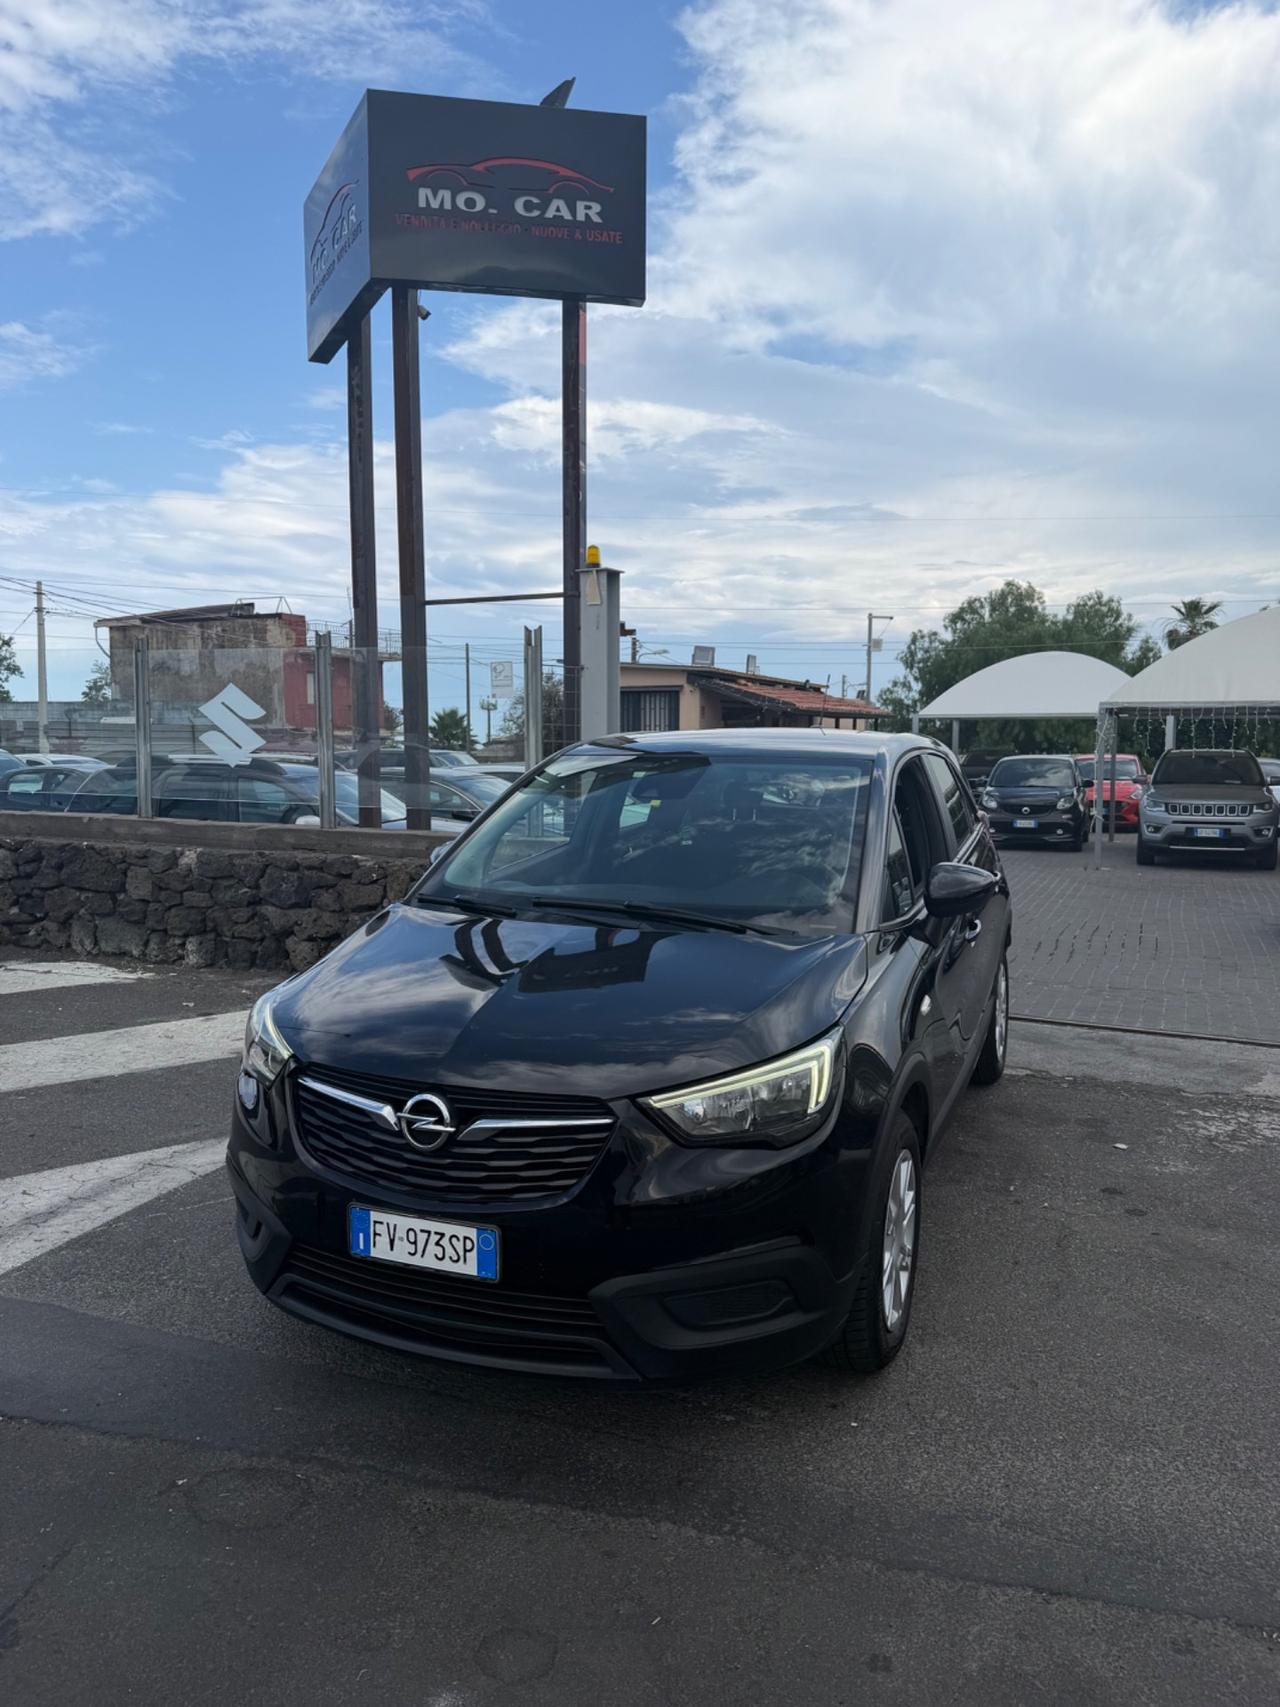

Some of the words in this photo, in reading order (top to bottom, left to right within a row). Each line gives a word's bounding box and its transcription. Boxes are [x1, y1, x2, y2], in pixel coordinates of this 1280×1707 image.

[417, 187, 498, 214] MO.
[513, 195, 603, 223] CAR
[531, 225, 571, 240] NUOVE
[586, 230, 623, 245] USATE
